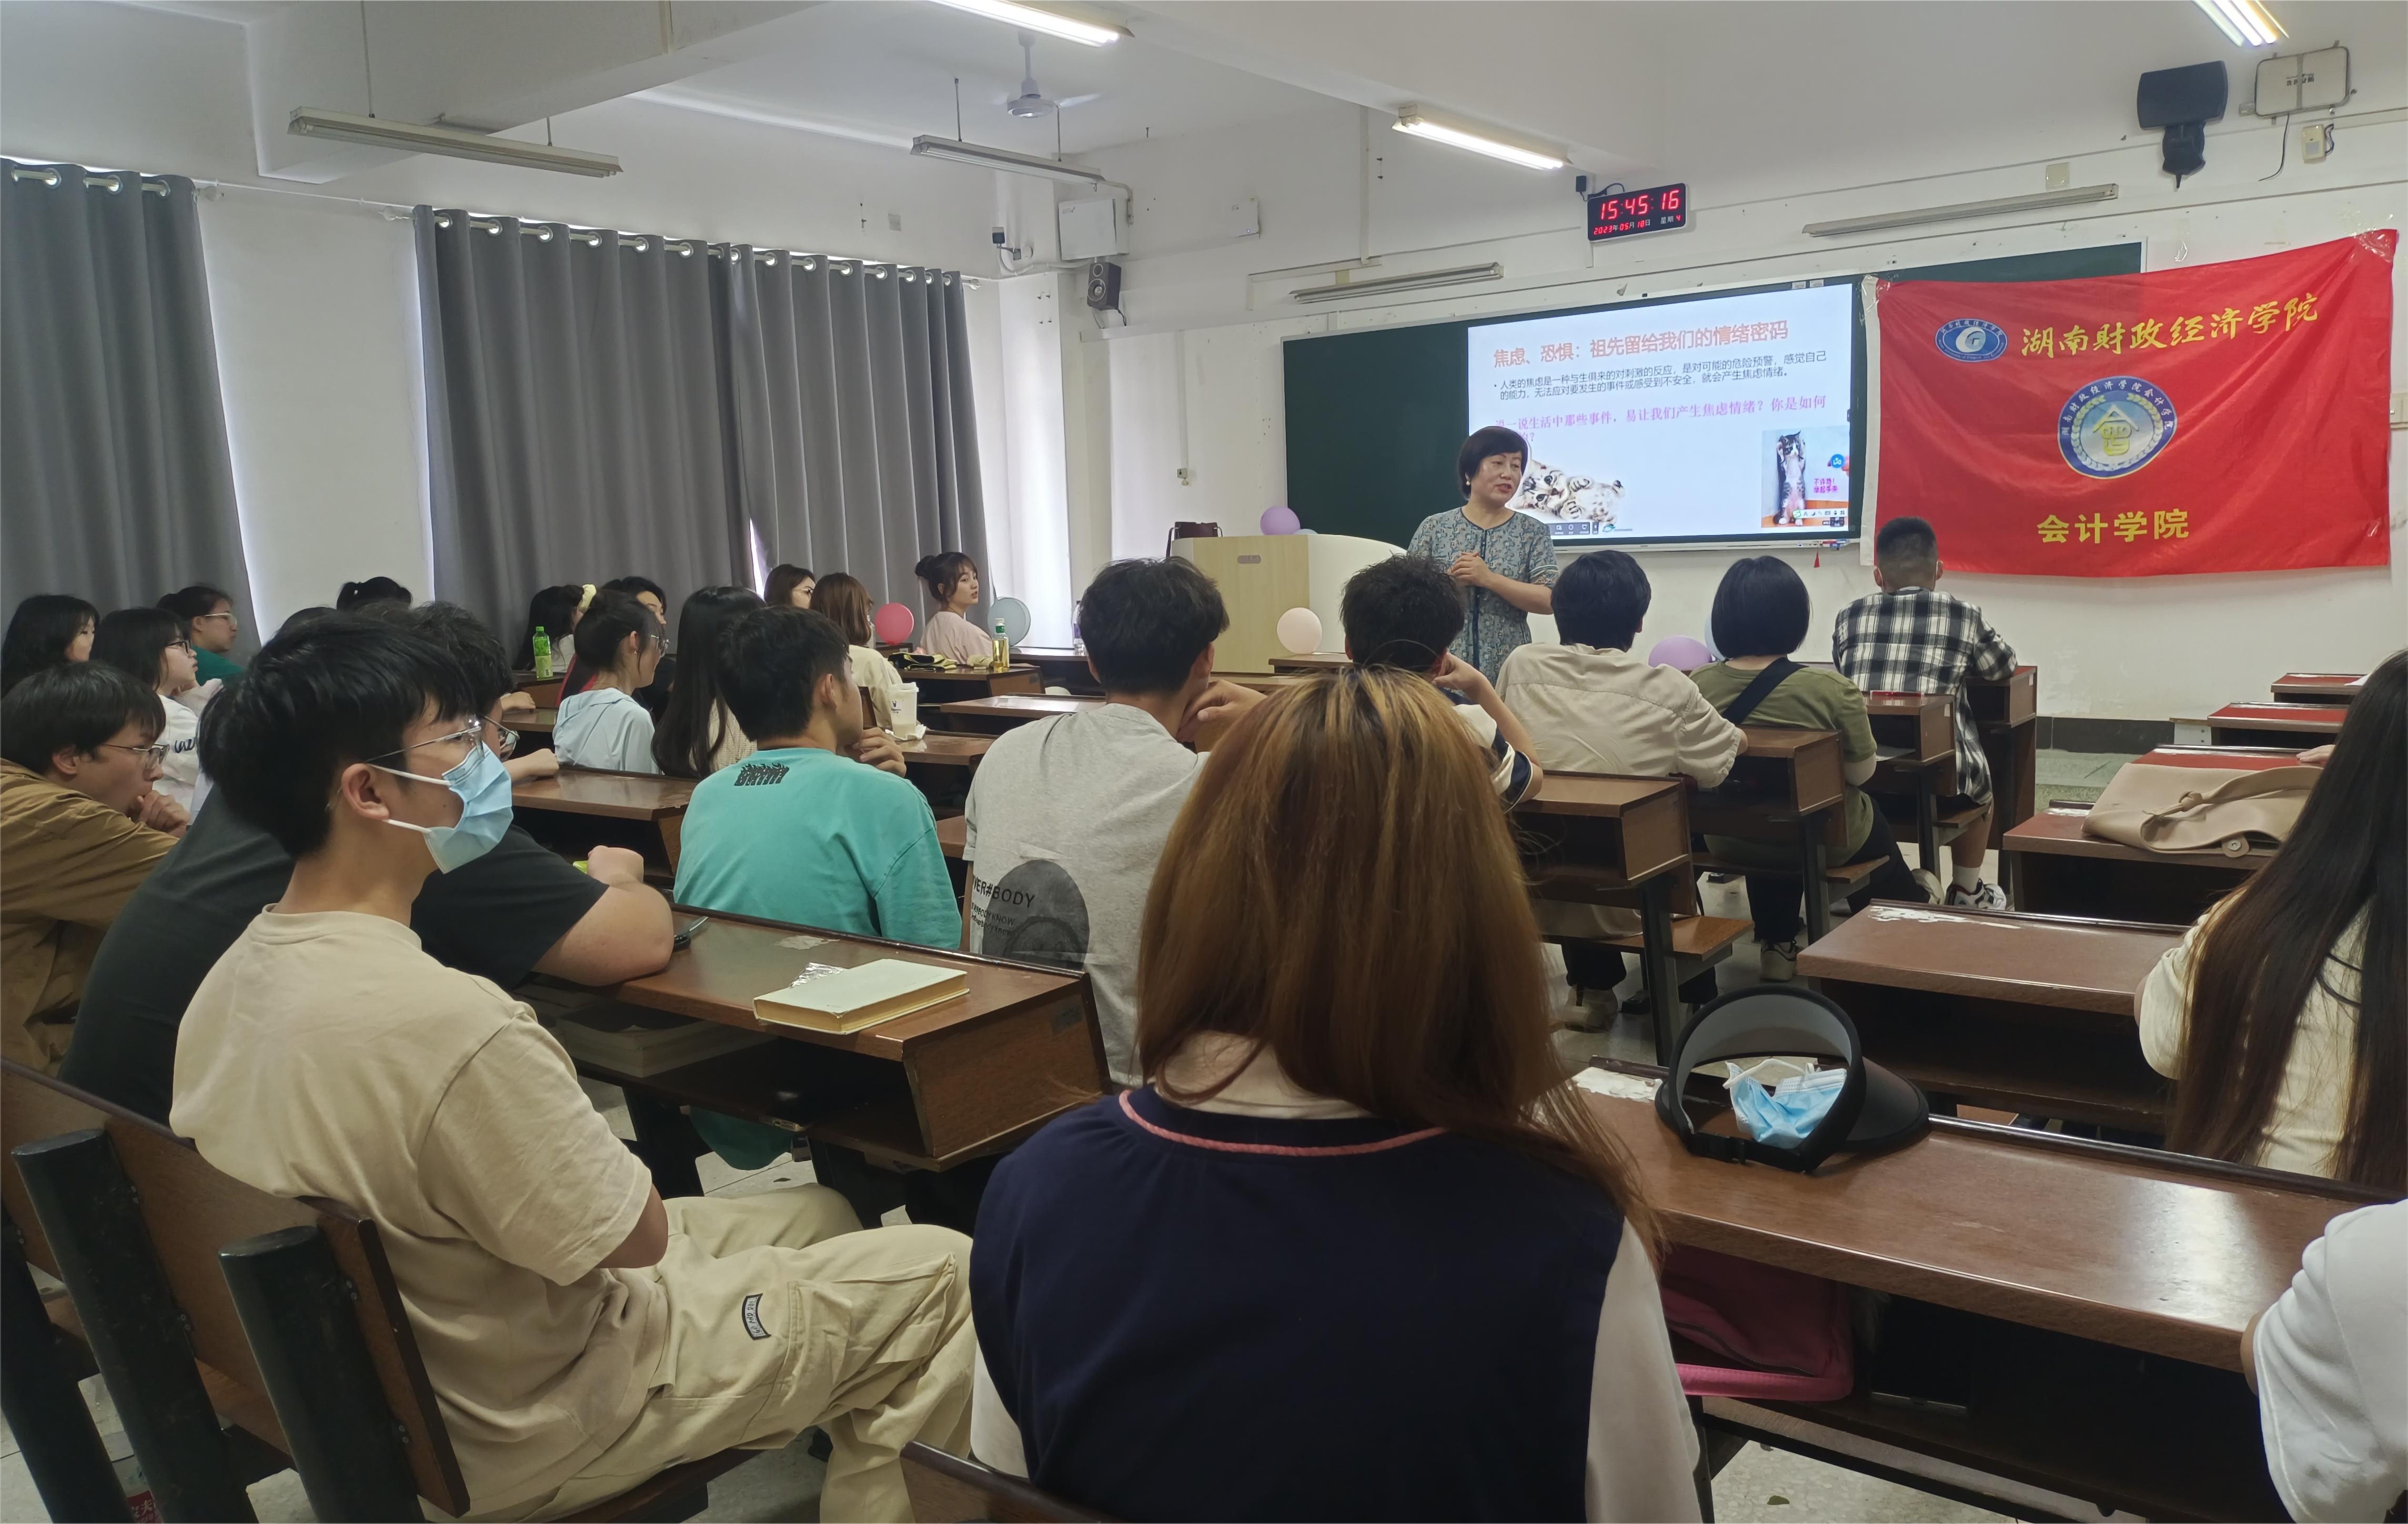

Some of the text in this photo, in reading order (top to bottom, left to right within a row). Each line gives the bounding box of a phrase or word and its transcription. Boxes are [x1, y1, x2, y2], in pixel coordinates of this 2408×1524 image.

[1493, 319, 1788, 368] 焦虑、恐惧：祖先留给我们的情绪密码
[2021, 292, 2318, 358] 湖南财政经济学院
[2037, 508, 2189, 544] 会计学院
